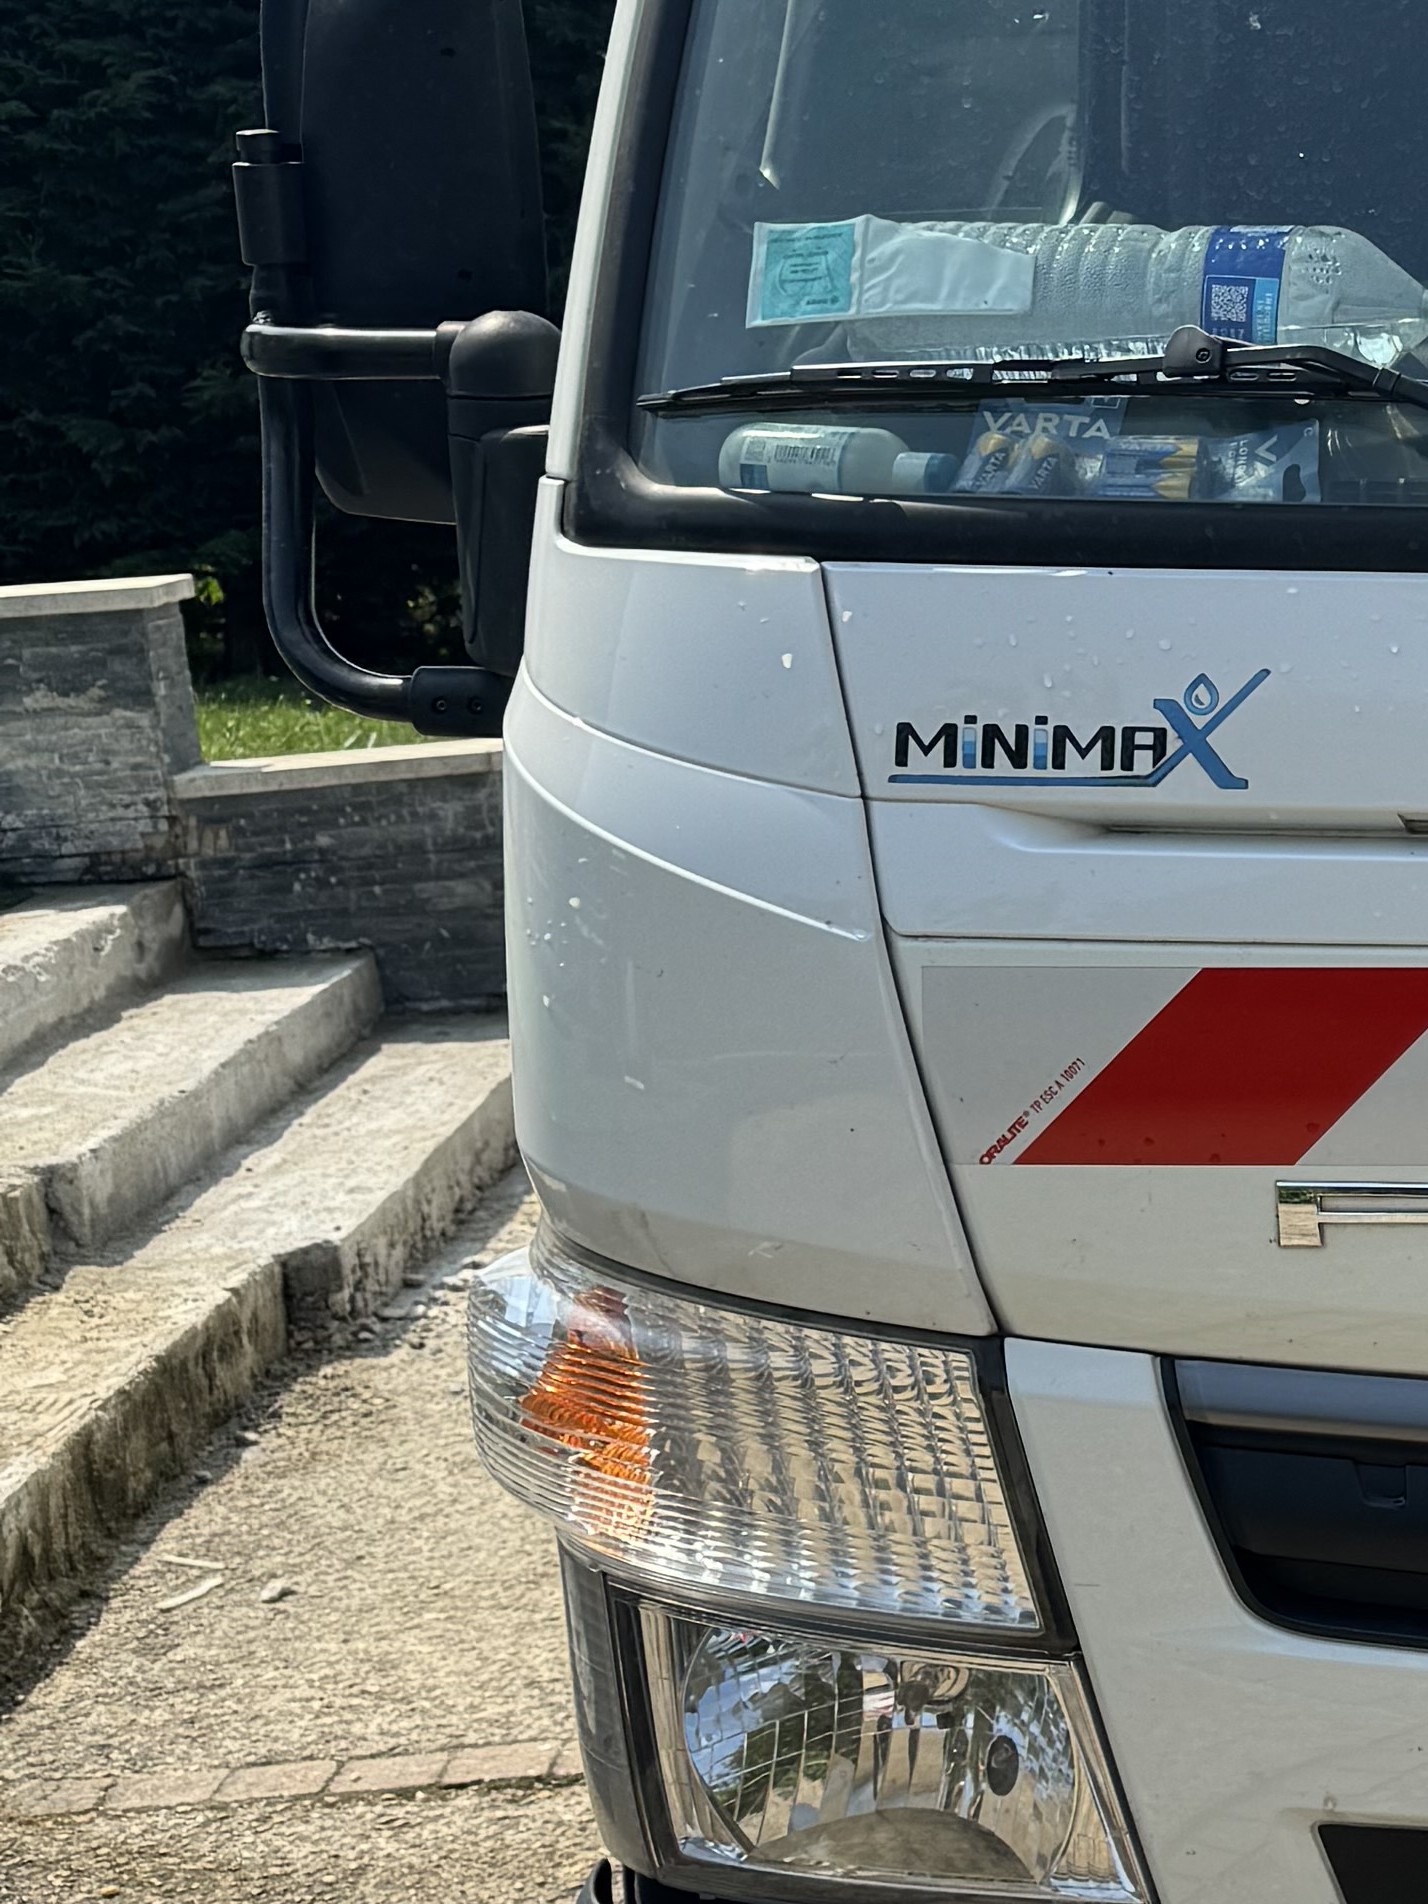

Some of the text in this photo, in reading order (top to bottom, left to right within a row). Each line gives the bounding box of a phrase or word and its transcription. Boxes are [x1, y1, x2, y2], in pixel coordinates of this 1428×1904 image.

[981, 410, 1112, 440] VARTA
[976, 451, 1007, 486] VARTA
[1028, 456, 1059, 489] VARTA
[1060, 1057, 1086, 1082] 10071
